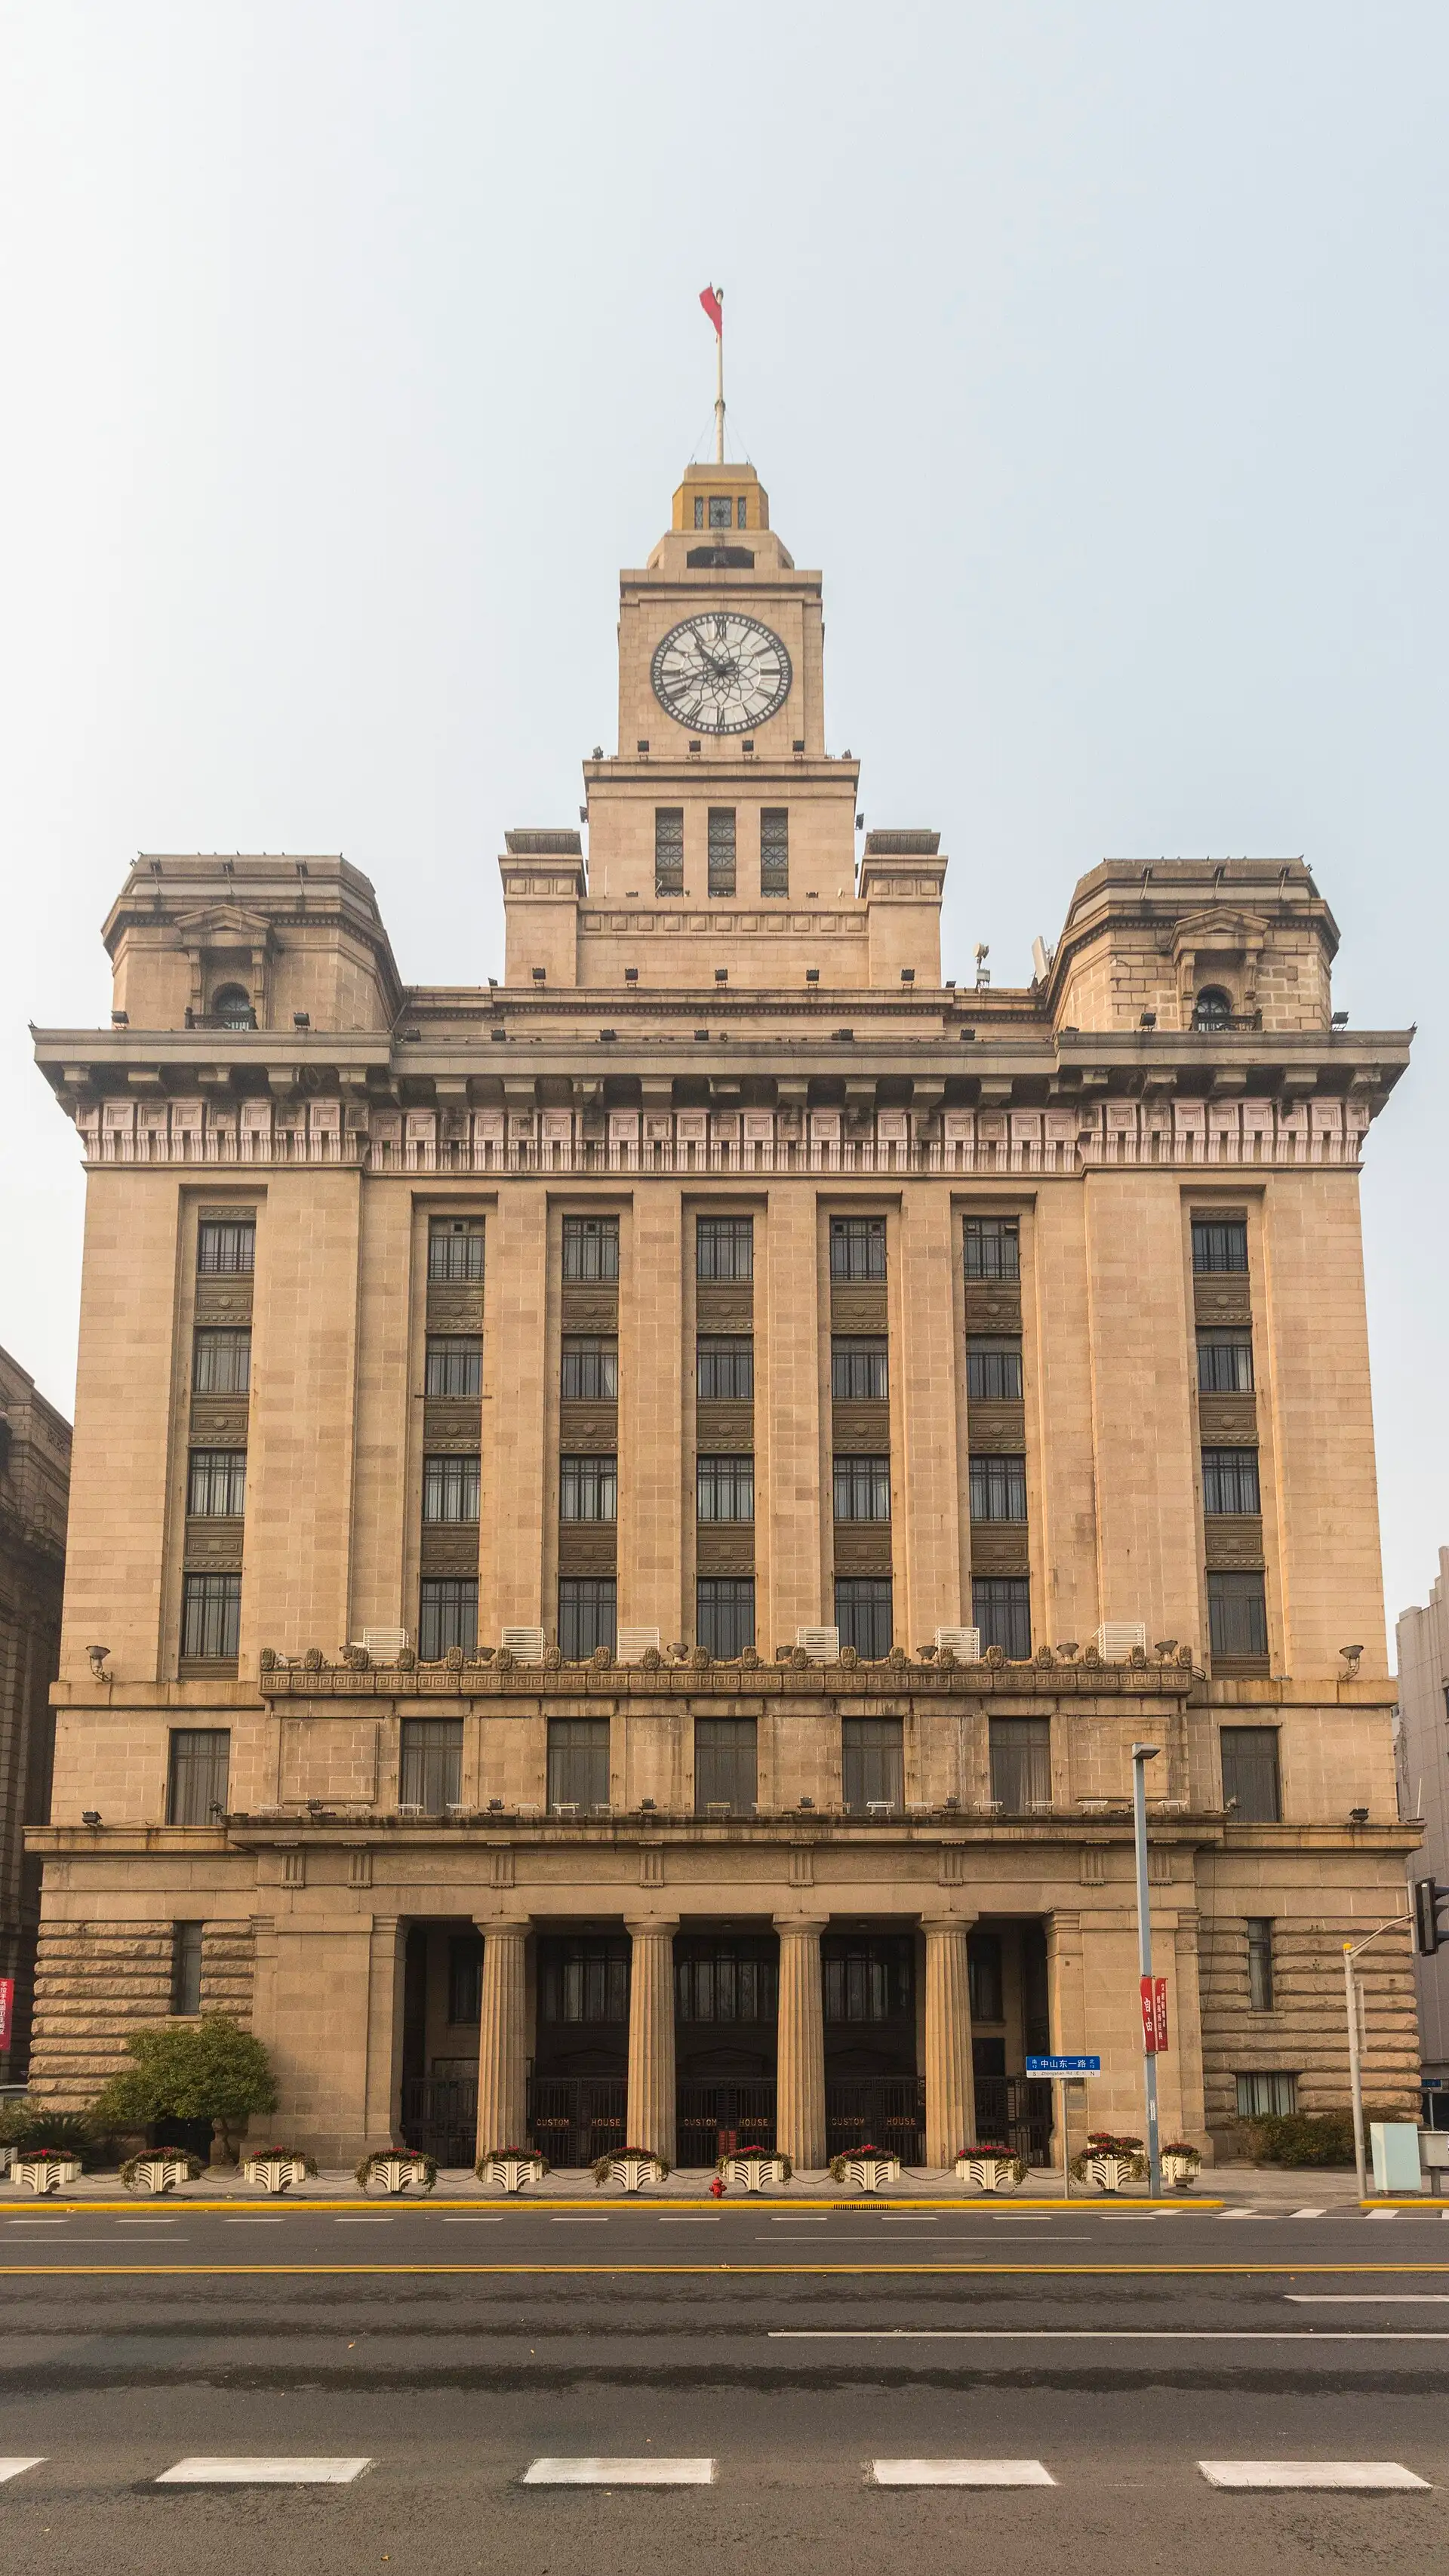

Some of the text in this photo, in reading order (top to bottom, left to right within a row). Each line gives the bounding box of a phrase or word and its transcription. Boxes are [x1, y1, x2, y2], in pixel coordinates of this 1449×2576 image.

[1041, 2059, 1086, 2068] 中山东一路
